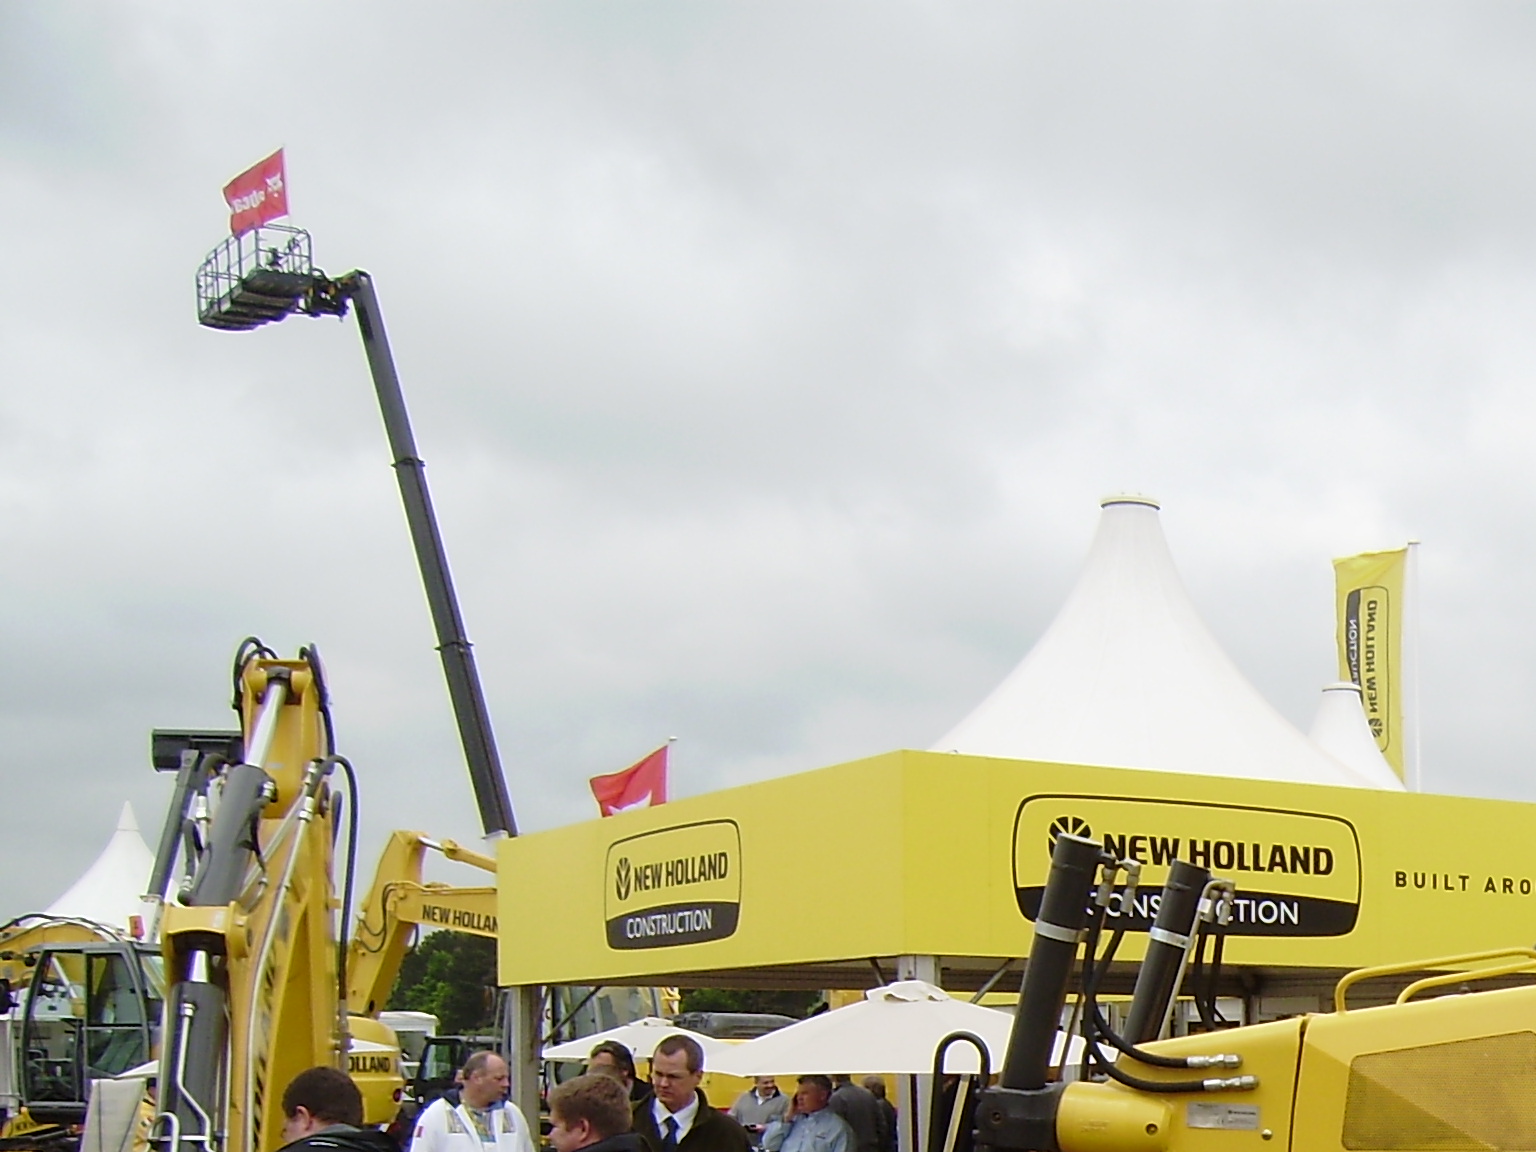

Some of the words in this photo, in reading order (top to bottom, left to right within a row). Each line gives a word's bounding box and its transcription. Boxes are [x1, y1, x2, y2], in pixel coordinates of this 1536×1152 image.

[1103, 833, 1181, 866] NEW
[1189, 838, 1335, 876] HOLLAND
[634, 862, 663, 893] NEW
[665, 852, 729, 888] HOLLAND
[1394, 870, 1470, 893] BUILT
[422, 904, 450, 924] NEW
[626, 908, 713, 940] CONSTRUCTION
